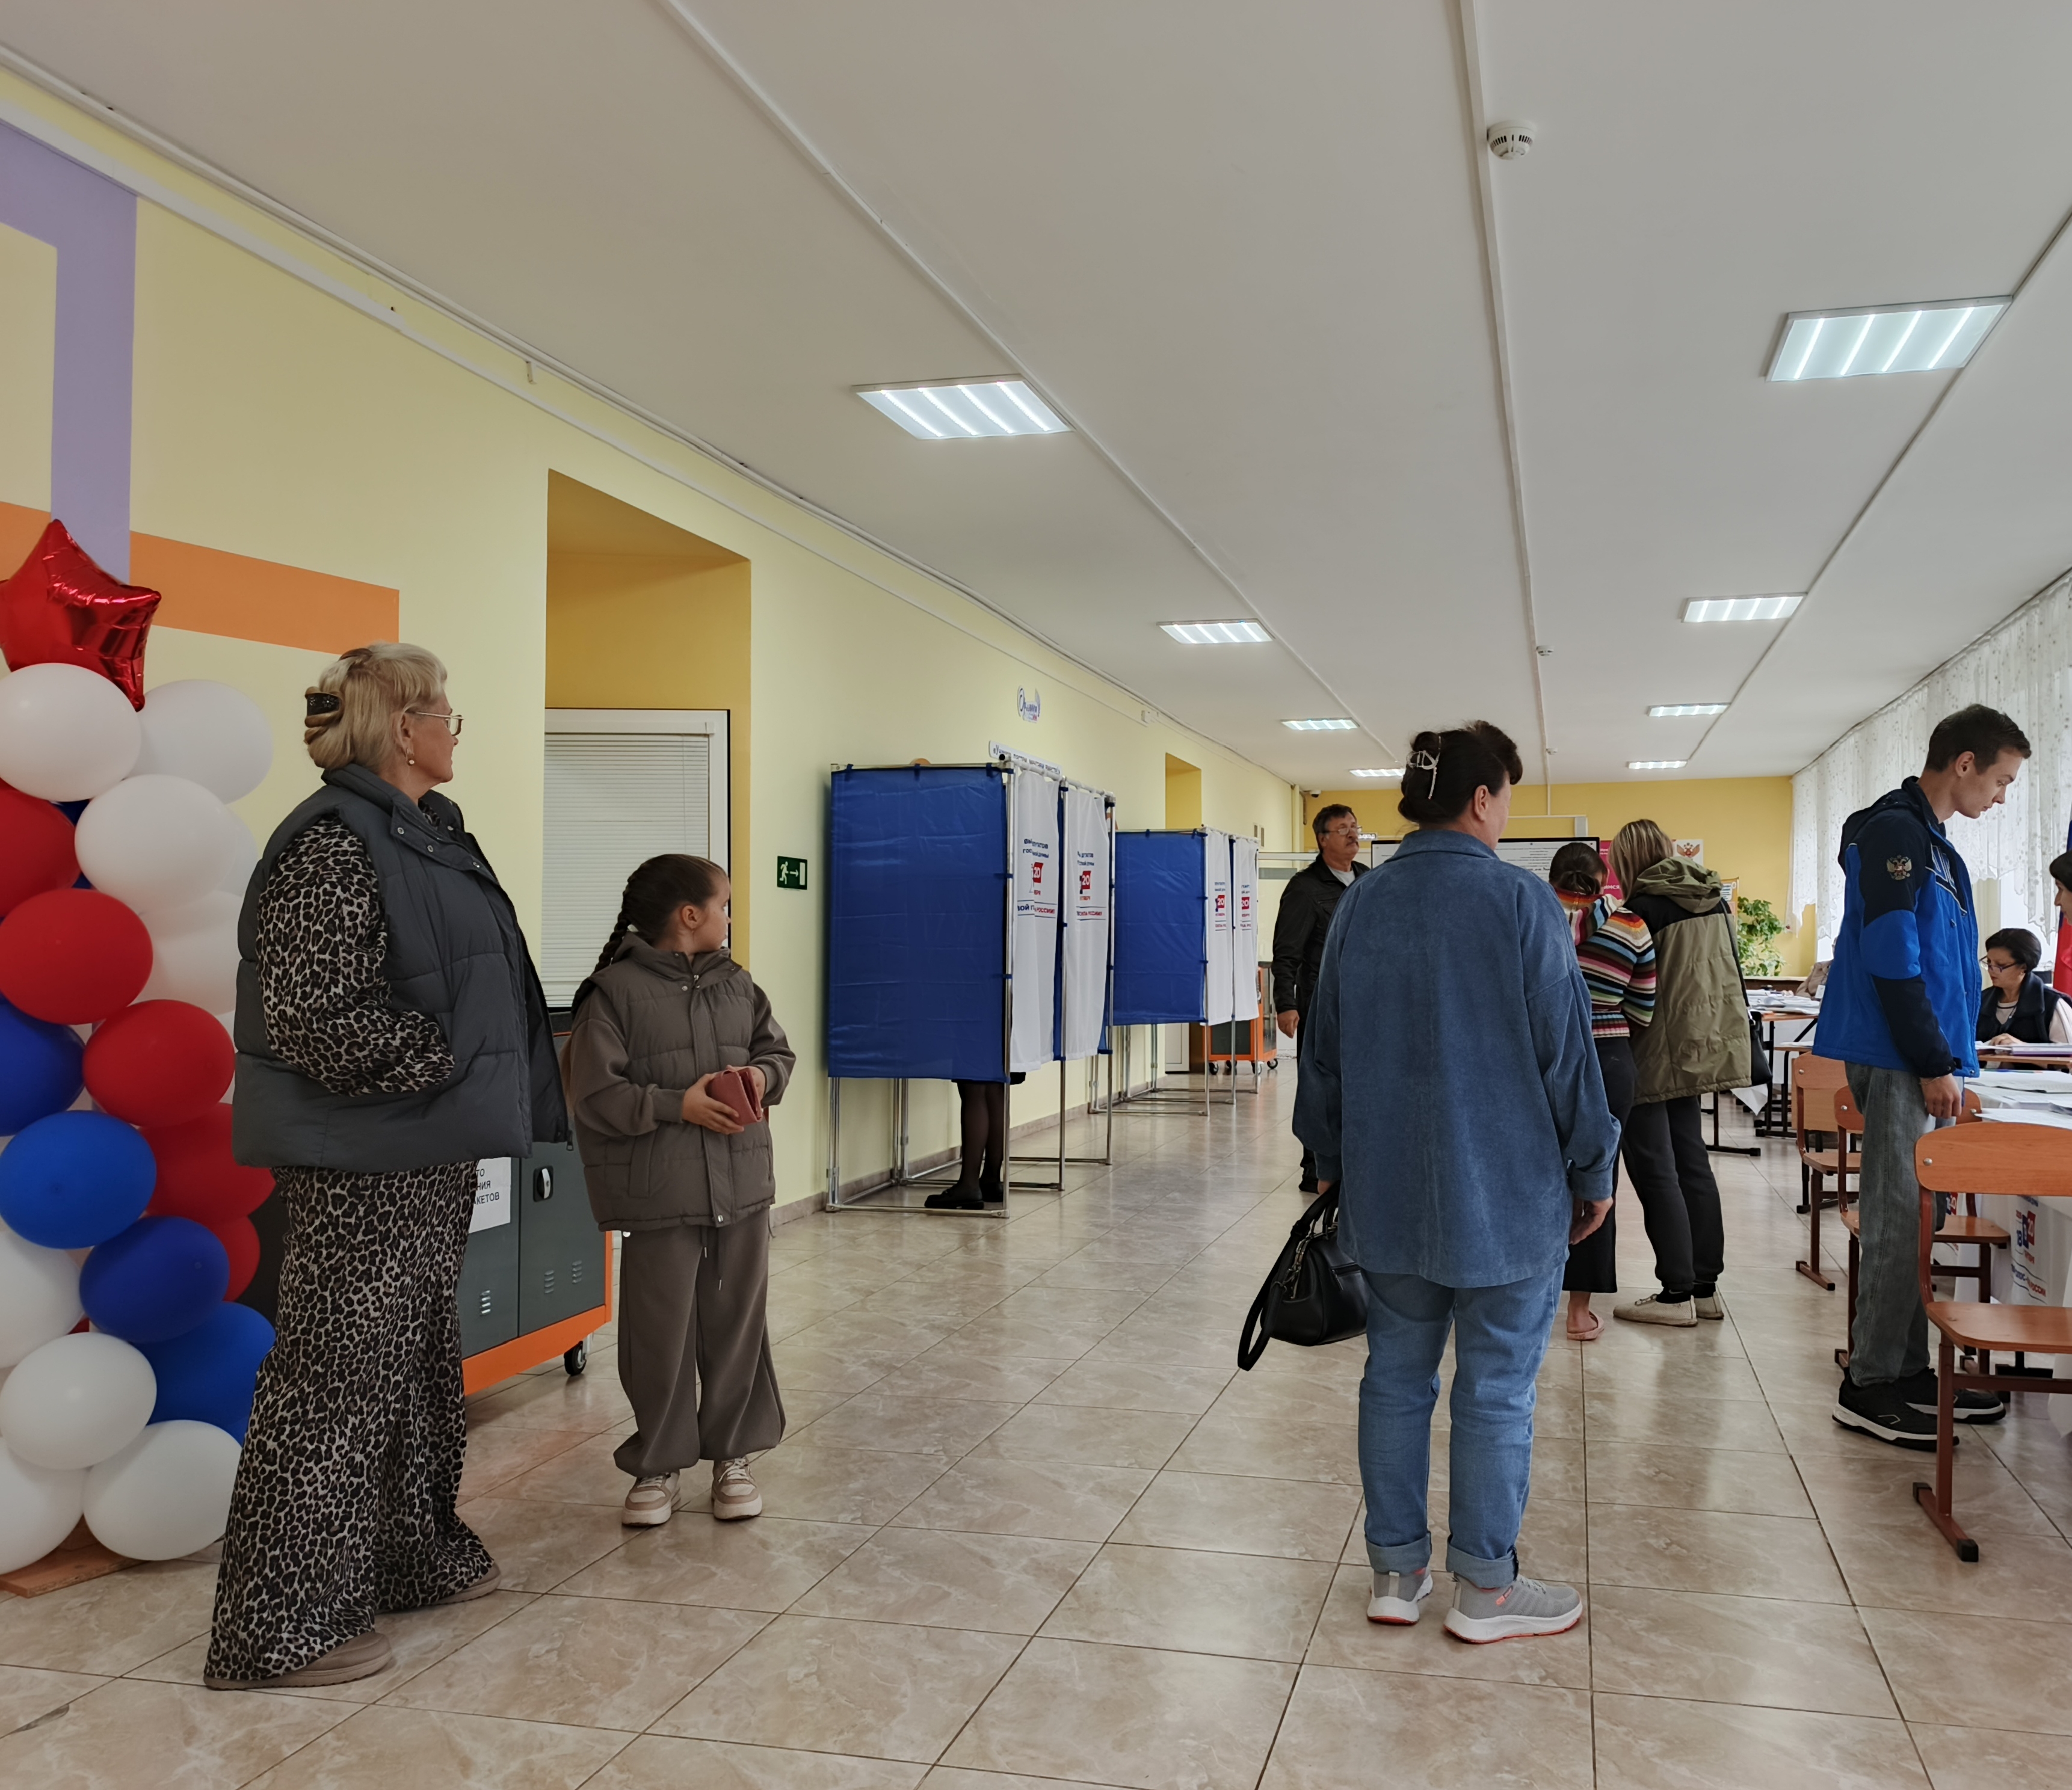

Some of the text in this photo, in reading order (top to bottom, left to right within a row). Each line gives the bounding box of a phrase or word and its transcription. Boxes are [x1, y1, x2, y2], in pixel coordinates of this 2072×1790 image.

[1034, 867, 1041, 878] 20
[1082, 875, 1090, 885] 20
[476, 1169, 485, 1177] ТО
[477, 1180, 491, 1190] НИЯ
[475, 1192, 499, 1205] КЕТОВ
